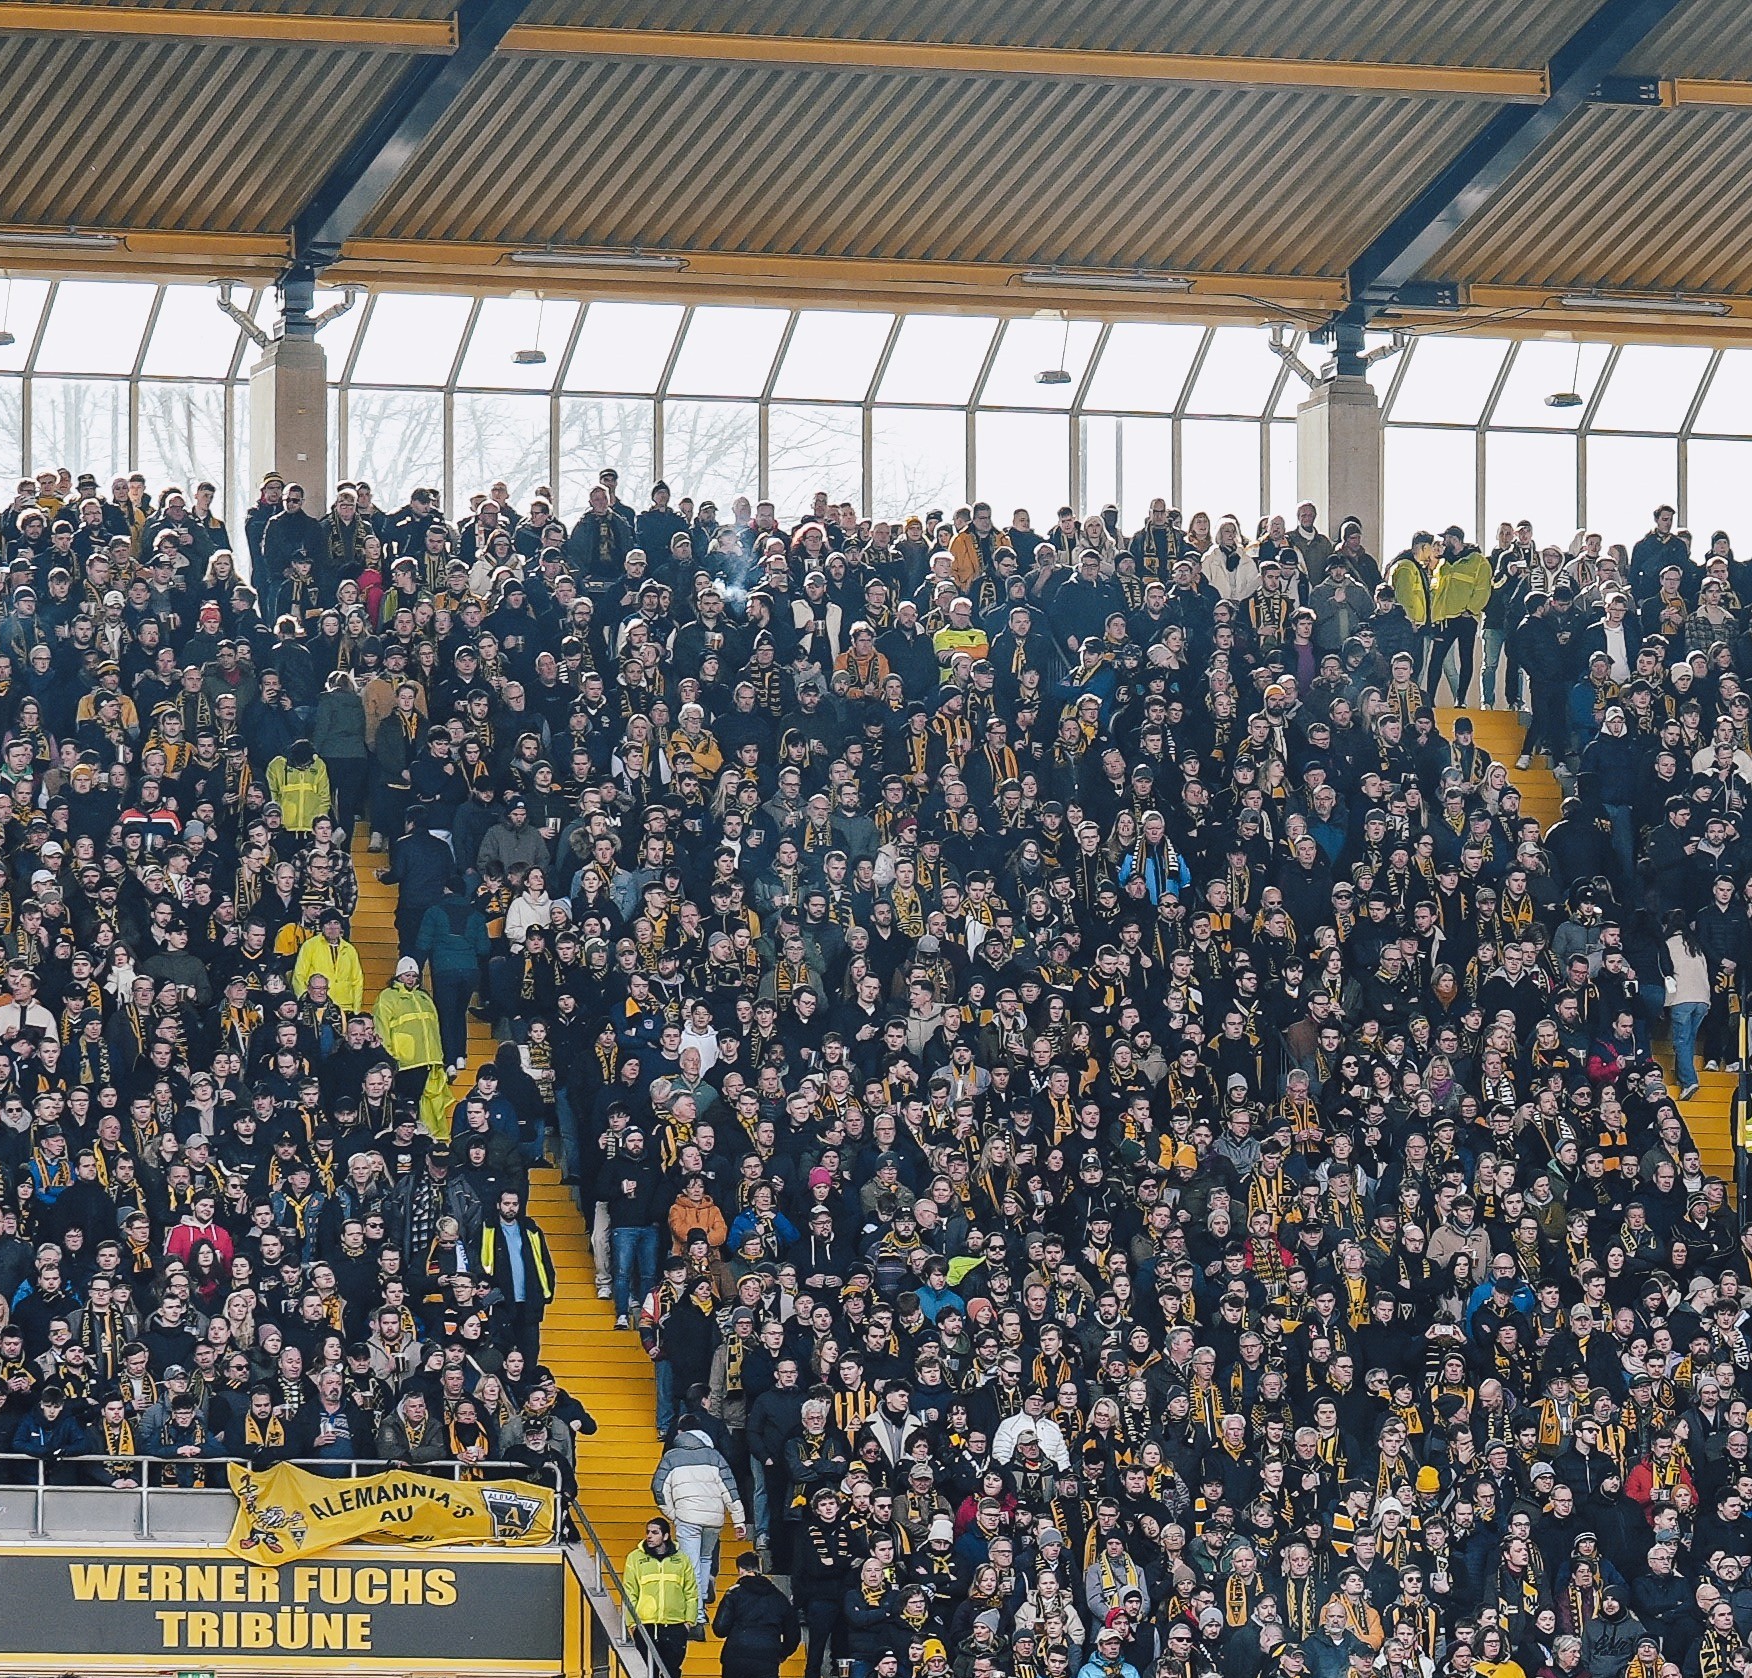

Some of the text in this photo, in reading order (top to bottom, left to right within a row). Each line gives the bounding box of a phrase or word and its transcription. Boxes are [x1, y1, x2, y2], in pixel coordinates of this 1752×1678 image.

[379, 1505, 414, 1523] AU
[70, 1563, 458, 1607] WERNER FUCHS
[156, 1603, 372, 1651] TRIBÜNE
